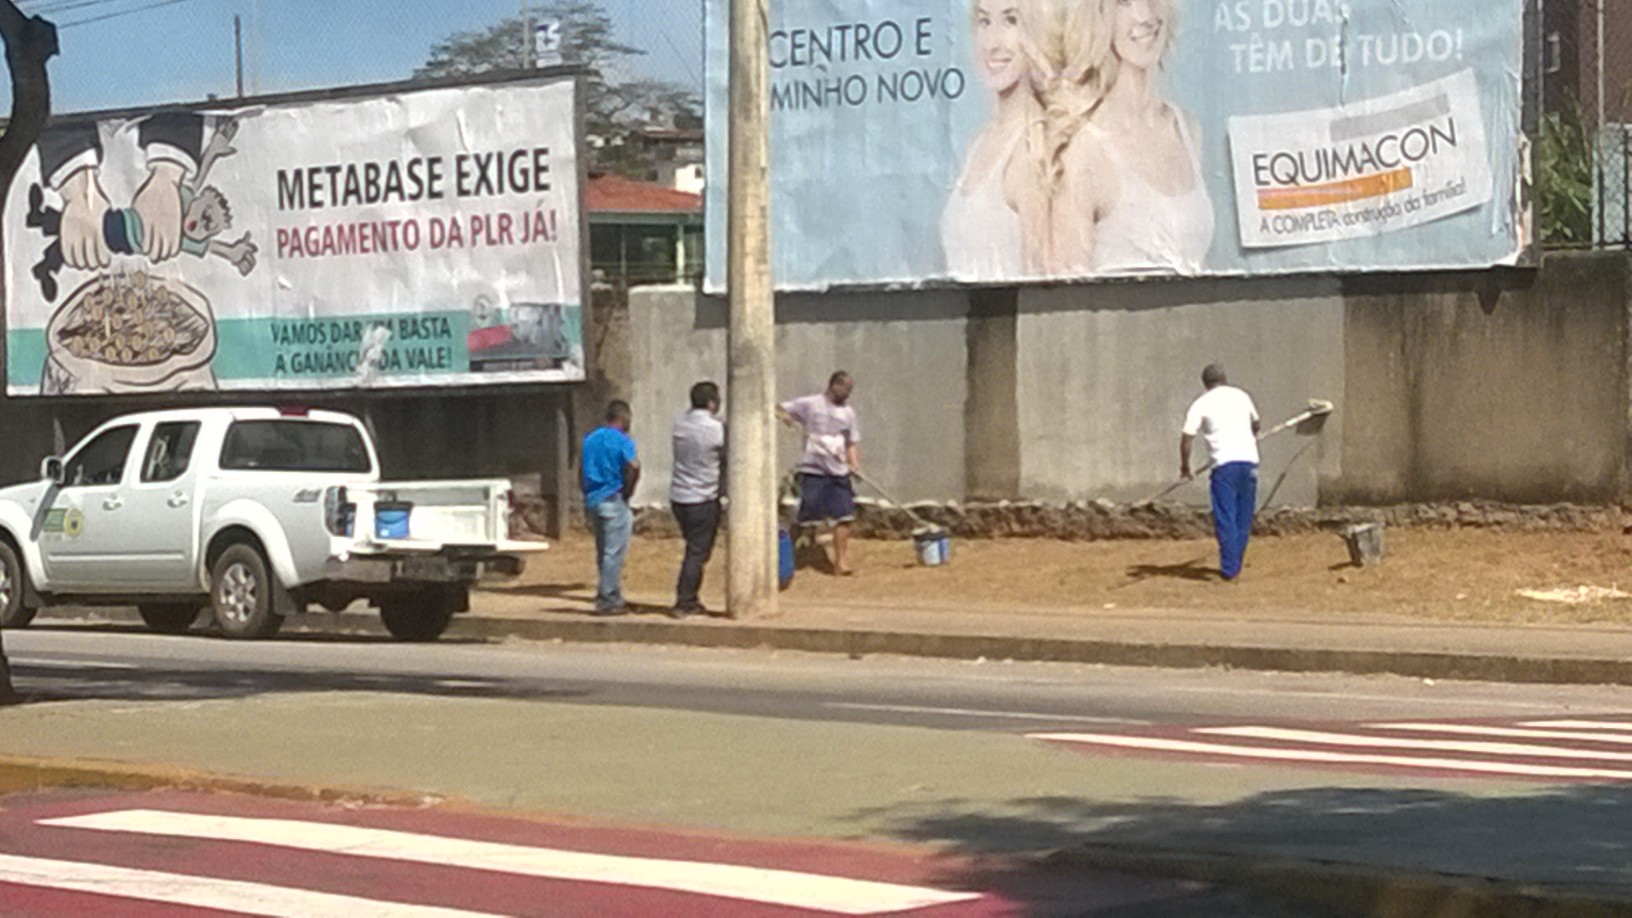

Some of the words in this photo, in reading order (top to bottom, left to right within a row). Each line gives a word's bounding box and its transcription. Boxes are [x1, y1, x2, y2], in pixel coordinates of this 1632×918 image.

[1214, 1, 1251, 32] AS
[769, 20, 903, 69] CENTRO
[915, 17, 932, 56] E
[1229, 31, 1295, 74] TÊM
[1304, 34, 1346, 68] DE
[1357, 28, 1464, 67] TUDO!
[769, 75, 867, 112] MINHO
[877, 67, 965, 104] NOVO
[1252, 117, 1457, 186] EQUIMACON
[277, 156, 444, 211] METABASE
[455, 147, 551, 197] EXIGE
[277, 218, 420, 259] PAGAMENTO
[429, 215, 464, 250] DA
[470, 212, 514, 247] PLR
[521, 198, 558, 244] JÁ!
[1258, 220, 1270, 234] A
[1272, 208, 1341, 235] COMPLETA
[1342, 200, 1402, 227] construção
[1404, 193, 1421, 213] da
[270, 321, 327, 346] VAMOS
[330, 319, 363, 343] DAR
[398, 315, 452, 340] BASTA
[274, 352, 287, 374] A
[291, 344, 372, 374] GANÂNCI
[379, 348, 402, 371] DA
[405, 346, 453, 369] VALE!
